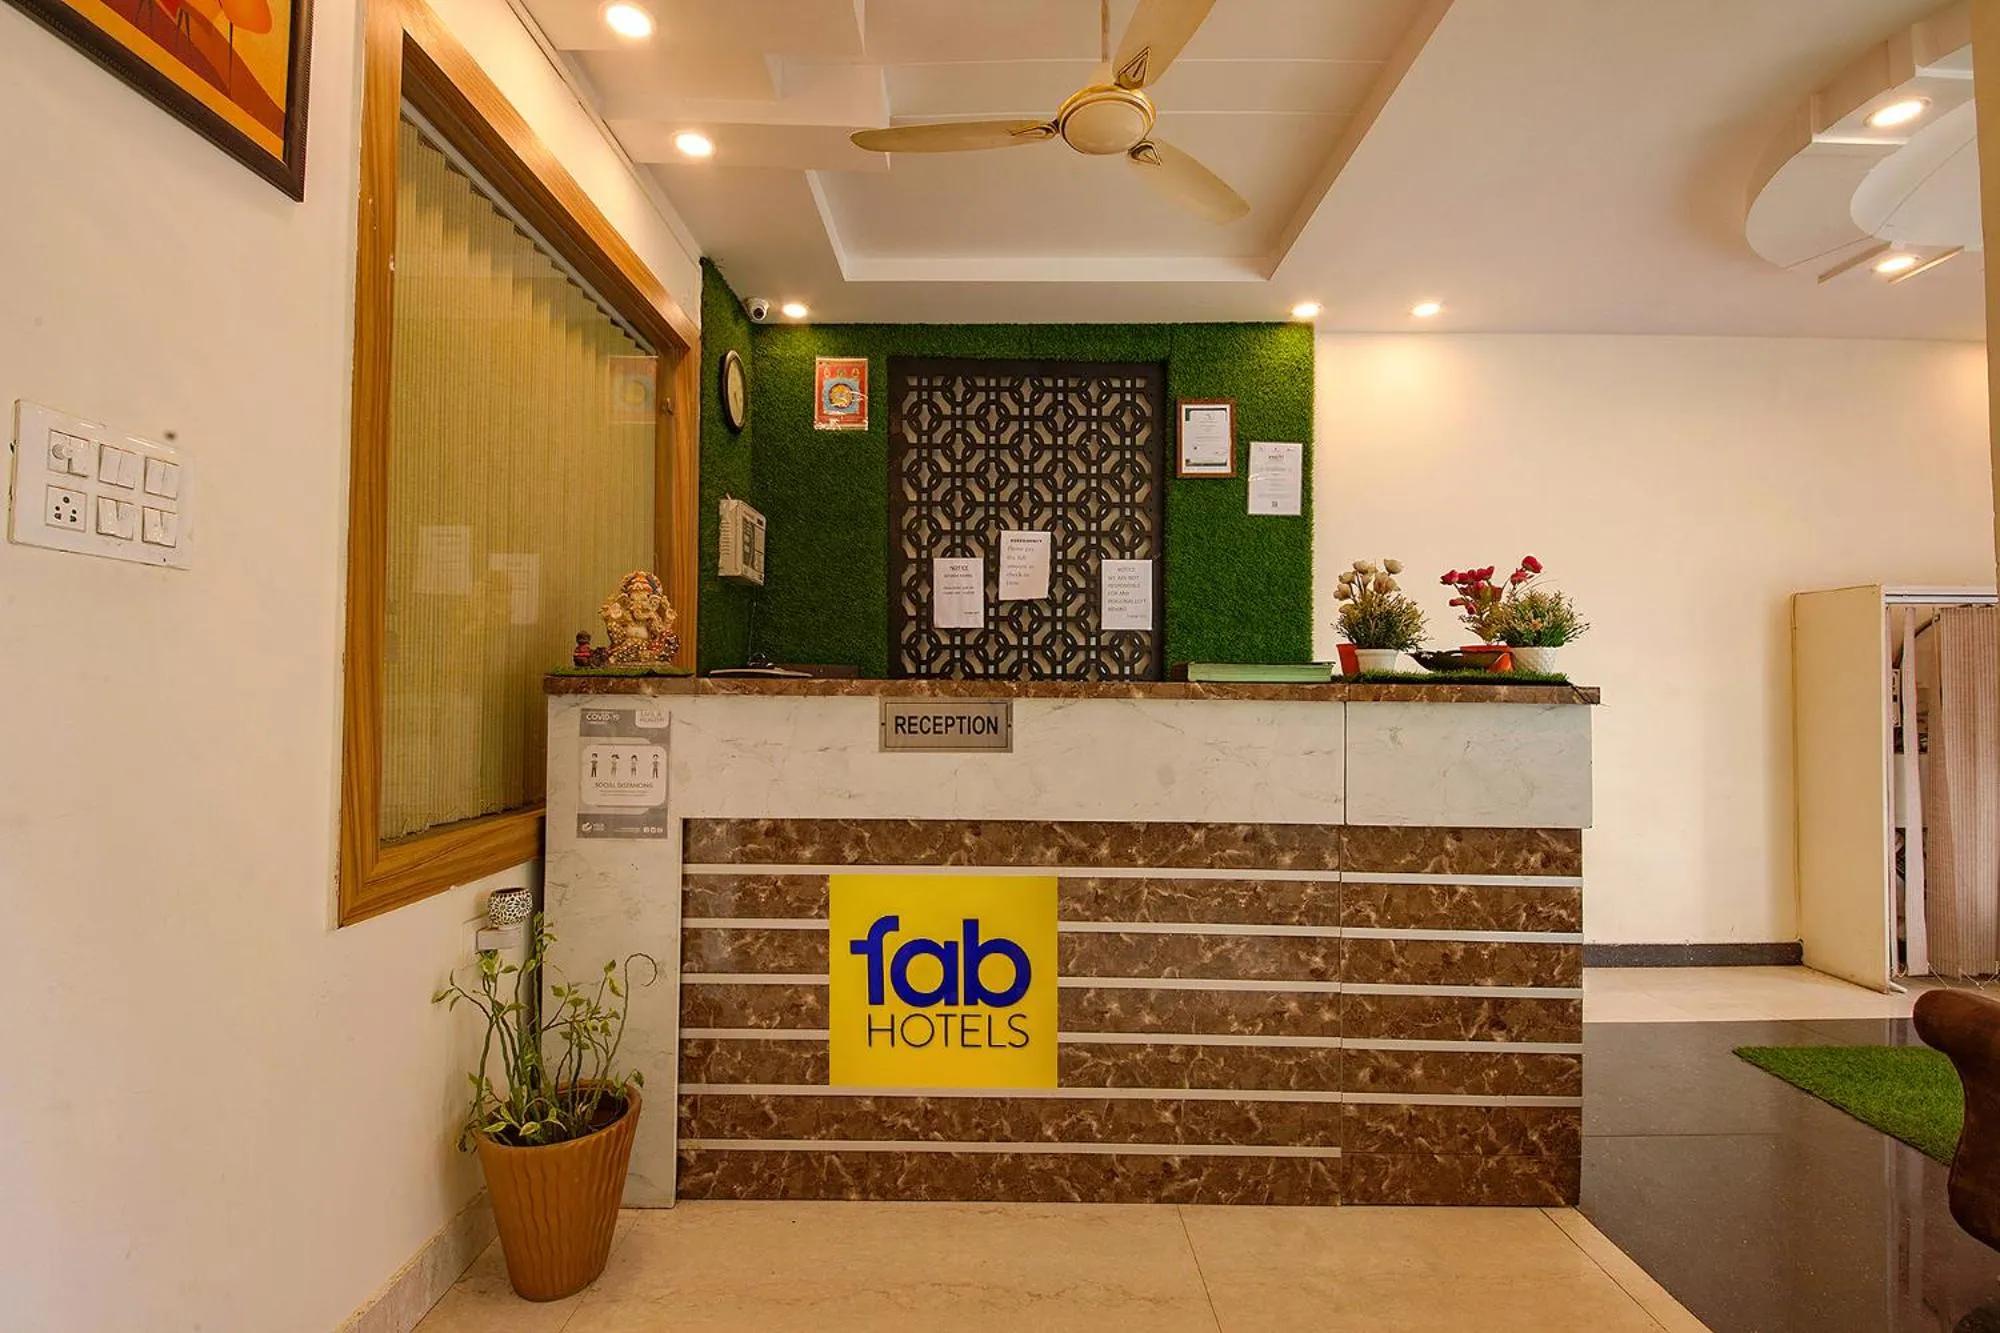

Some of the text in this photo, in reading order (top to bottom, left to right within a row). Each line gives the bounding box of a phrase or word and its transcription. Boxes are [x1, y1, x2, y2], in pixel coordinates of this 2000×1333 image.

[894, 715, 998, 735] RECEPTION
[850, 915, 1032, 1008] fab
[867, 1013, 1030, 1048] HOTELS
